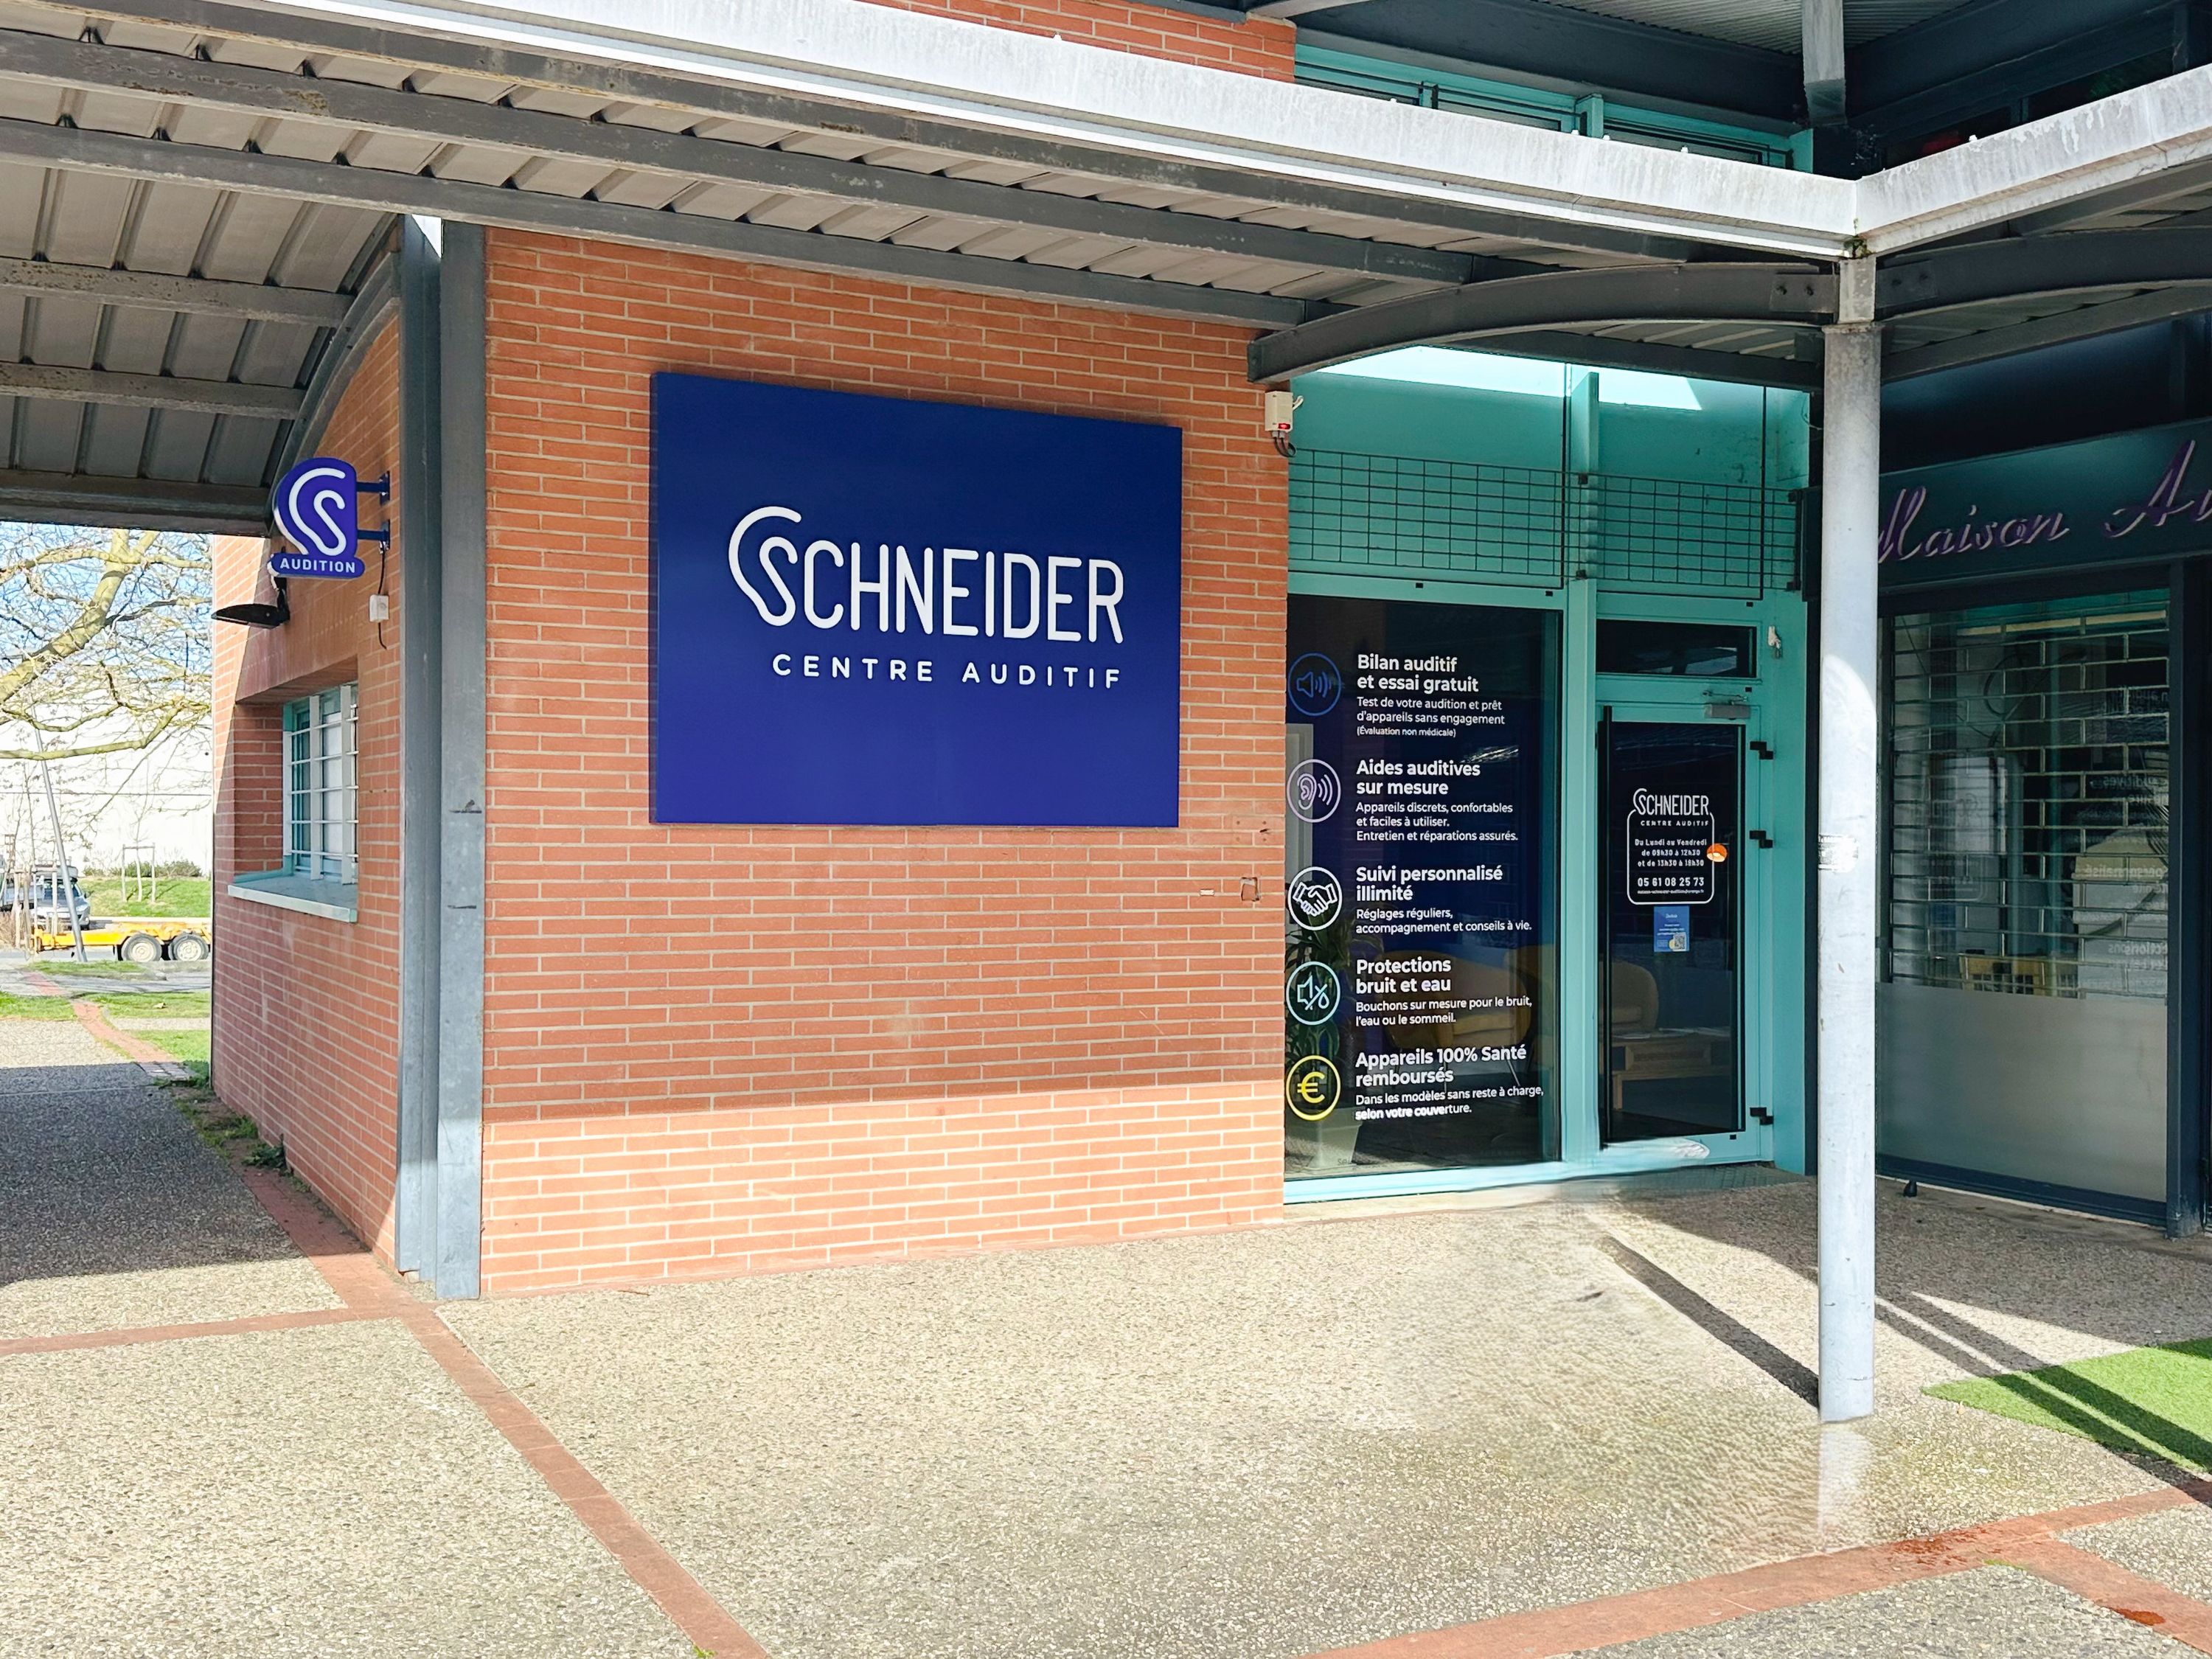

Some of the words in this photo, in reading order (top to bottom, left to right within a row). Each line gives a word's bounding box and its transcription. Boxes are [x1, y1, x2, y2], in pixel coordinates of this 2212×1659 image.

[280, 558, 355, 573] AUDITION
[728, 506, 1124, 643] SCHNEIDER
[1358, 654, 1399, 670] Bilan
[1404, 656, 1458, 672] auditif
[773, 653, 933, 682] CENTRE
[962, 662, 1119, 689] AUDITIF
[1357, 676, 1374, 689] et
[1378, 675, 1419, 690] essai
[1424, 676, 1479, 694] gratuit
[1357, 697, 1378, 707] Test
[1380, 698, 1394, 707] de
[1396, 699, 1422, 709] votre
[1425, 698, 1467, 709] audition
[1469, 701, 1479, 709] et
[1481, 700, 1502, 712] prêt
[1357, 712, 1413, 724] d'appareils
[1415, 714, 1438, 723] sans
[1440, 714, 1505, 726] engagement
[1357, 726, 1400, 736] (Évaluation
[1419, 728, 1455, 737] médicale)
[1356, 759, 1402, 775] Aides
[1407, 760, 1481, 776] auditives
[1357, 782, 1382, 795] sur
[1388, 783, 1448, 795] mesure
[1356, 802, 1405, 814] Appareils
[1408, 802, 1448, 814] discrets,
[1451, 803, 1513, 813] confortables
[1633, 788, 1709, 815] SCHNEIDER
[1356, 818, 1367, 826] et
[1369, 816, 1402, 827] faciles
[1405, 816, 1411, 826] à
[1413, 817, 1450, 827] utiliser.
[1357, 831, 1405, 841] Entretien
[1408, 832, 1417, 841] et
[1420, 830, 1477, 842] réparations
[1479, 830, 1518, 841] assurés.
[1356, 866, 1397, 882] Suivi
[1401, 864, 1503, 884] personnalisé
[1638, 877, 1649, 886] 05
[1652, 877, 1661, 886] 61
[1665, 877, 1676, 886] 08
[1680, 877, 1690, 886] 25
[1693, 877, 1704, 886] 73
[1356, 886, 1413, 901] illimité
[1357, 908, 1404, 920] Réglages
[1406, 908, 1453, 919] réguliers,
[1356, 922, 1451, 934] accompagnement
[1453, 923, 1463, 931] et
[1466, 921, 1505, 931] conseils
[1508, 921, 1513, 931] à
[1514, 920, 1532, 931] vie.
[1357, 957, 1451, 974] Protections
[1356, 978, 1397, 994] bruit
[1401, 979, 1417, 992] et
[1422, 979, 1451, 992] eau
[1356, 1001, 1408, 1012] Bouchons
[1411, 1002, 1426, 1010] sur
[1429, 999, 1467, 1009] mesure
[1469, 998, 1492, 1009] pour
[1495, 997, 1503, 1007] le
[1506, 997, 1532, 1007] bruit,
[1356, 1016, 1380, 1026] l'eau
[1382, 1017, 1396, 1026] ou
[1399, 1015, 1407, 1025] le
[1410, 1012, 1455, 1024] sommeil.
[1356, 1049, 1433, 1068] Appareils
[1437, 1048, 1478, 1064] 100%
[1481, 1044, 1526, 1061] Santé
[1356, 1065, 1453, 1087] remboursés
[1356, 1094, 1383, 1105] Dans
[1385, 1092, 1399, 1103] les
[1402, 1090, 1445, 1102] modèles
[1447, 1091, 1470, 1099] sans
[1472, 1089, 1497, 1099] reste
[1499, 1086, 1505, 1097] à
[1507, 1086, 1543, 1097] charge,
[1355, 1110, 1384, 1120] selon
[1385, 1108, 1412, 1119] votre
[1414, 1104, 1472, 1116] couverture.
